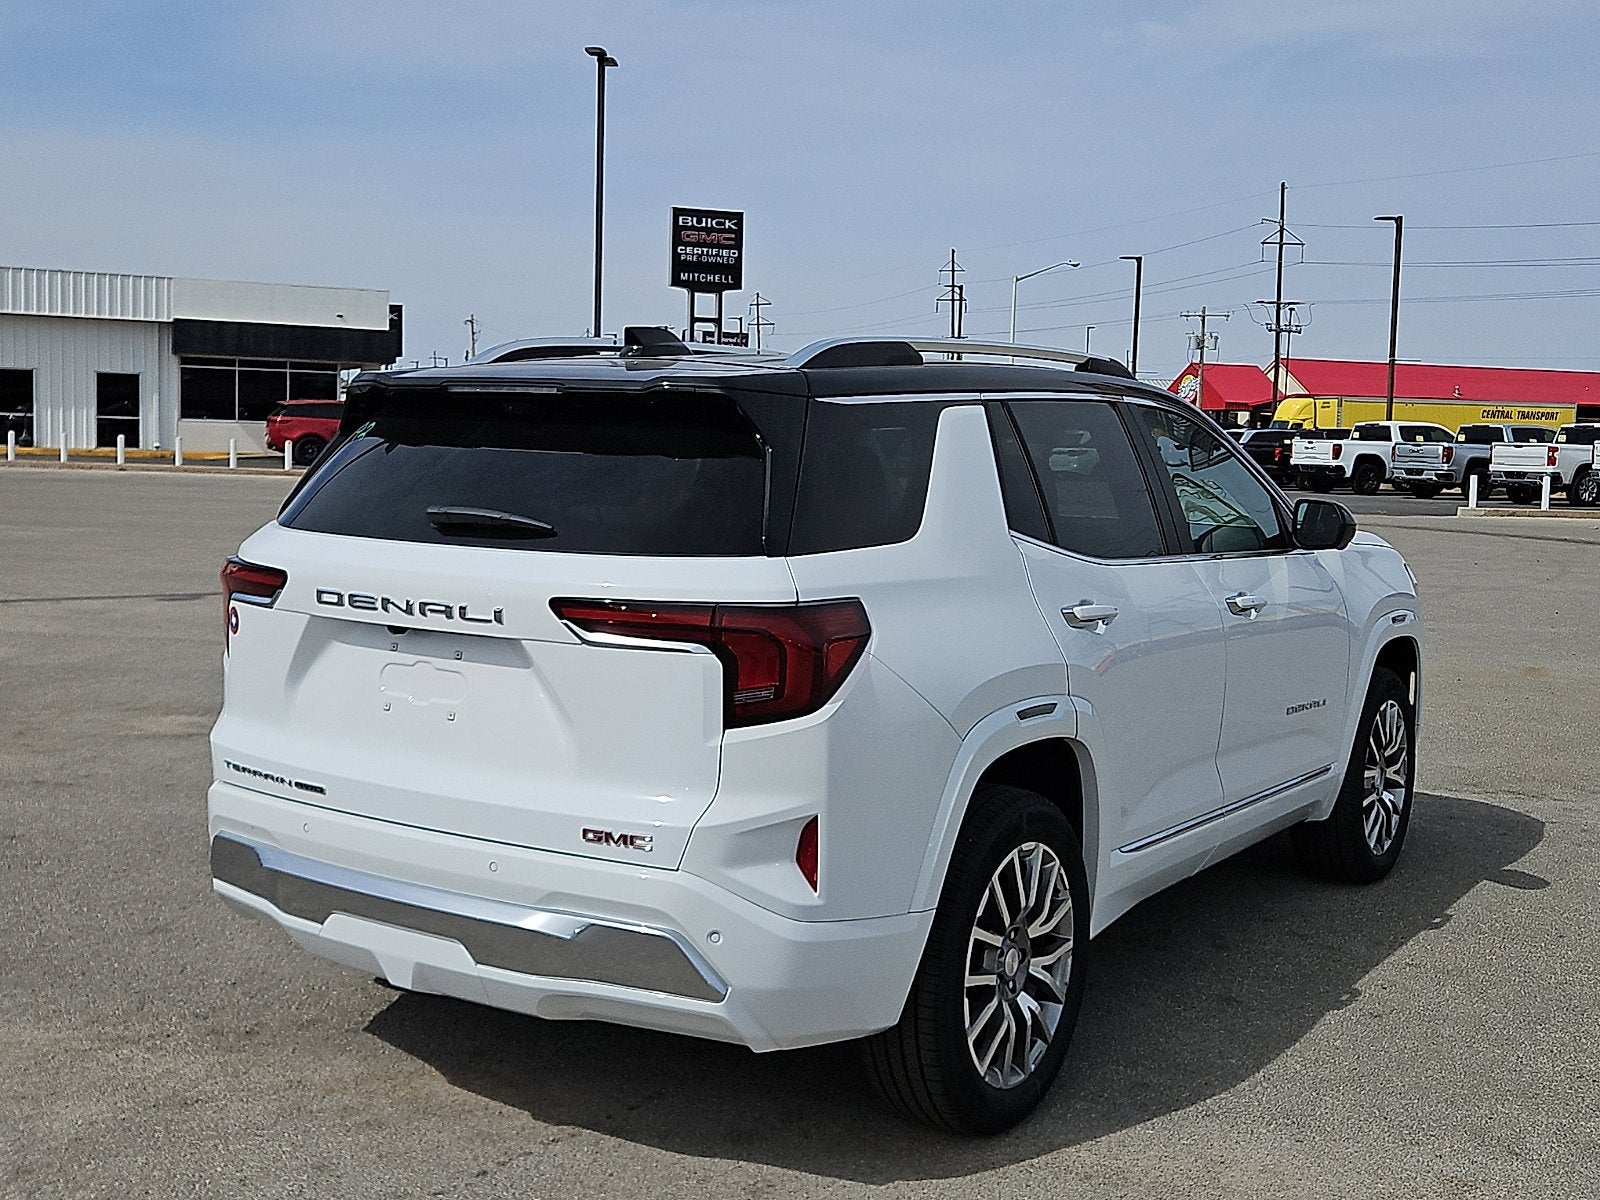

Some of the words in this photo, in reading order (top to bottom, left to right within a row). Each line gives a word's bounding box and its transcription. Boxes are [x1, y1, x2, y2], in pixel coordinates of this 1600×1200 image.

[678, 216, 739, 230] BUICK
[681, 230, 736, 245] GMC
[677, 246, 739, 258] CERTIFIED
[680, 254, 736, 265] PRE-OWNED
[680, 272, 734, 284] MITCHELL
[1481, 409, 1514, 420] CENTRAL
[1516, 410, 1560, 421] TRANSPORT
[315, 587, 505, 626] DENALI
[223, 758, 293, 788] TERRAIN
[581, 827, 654, 853] GMC
